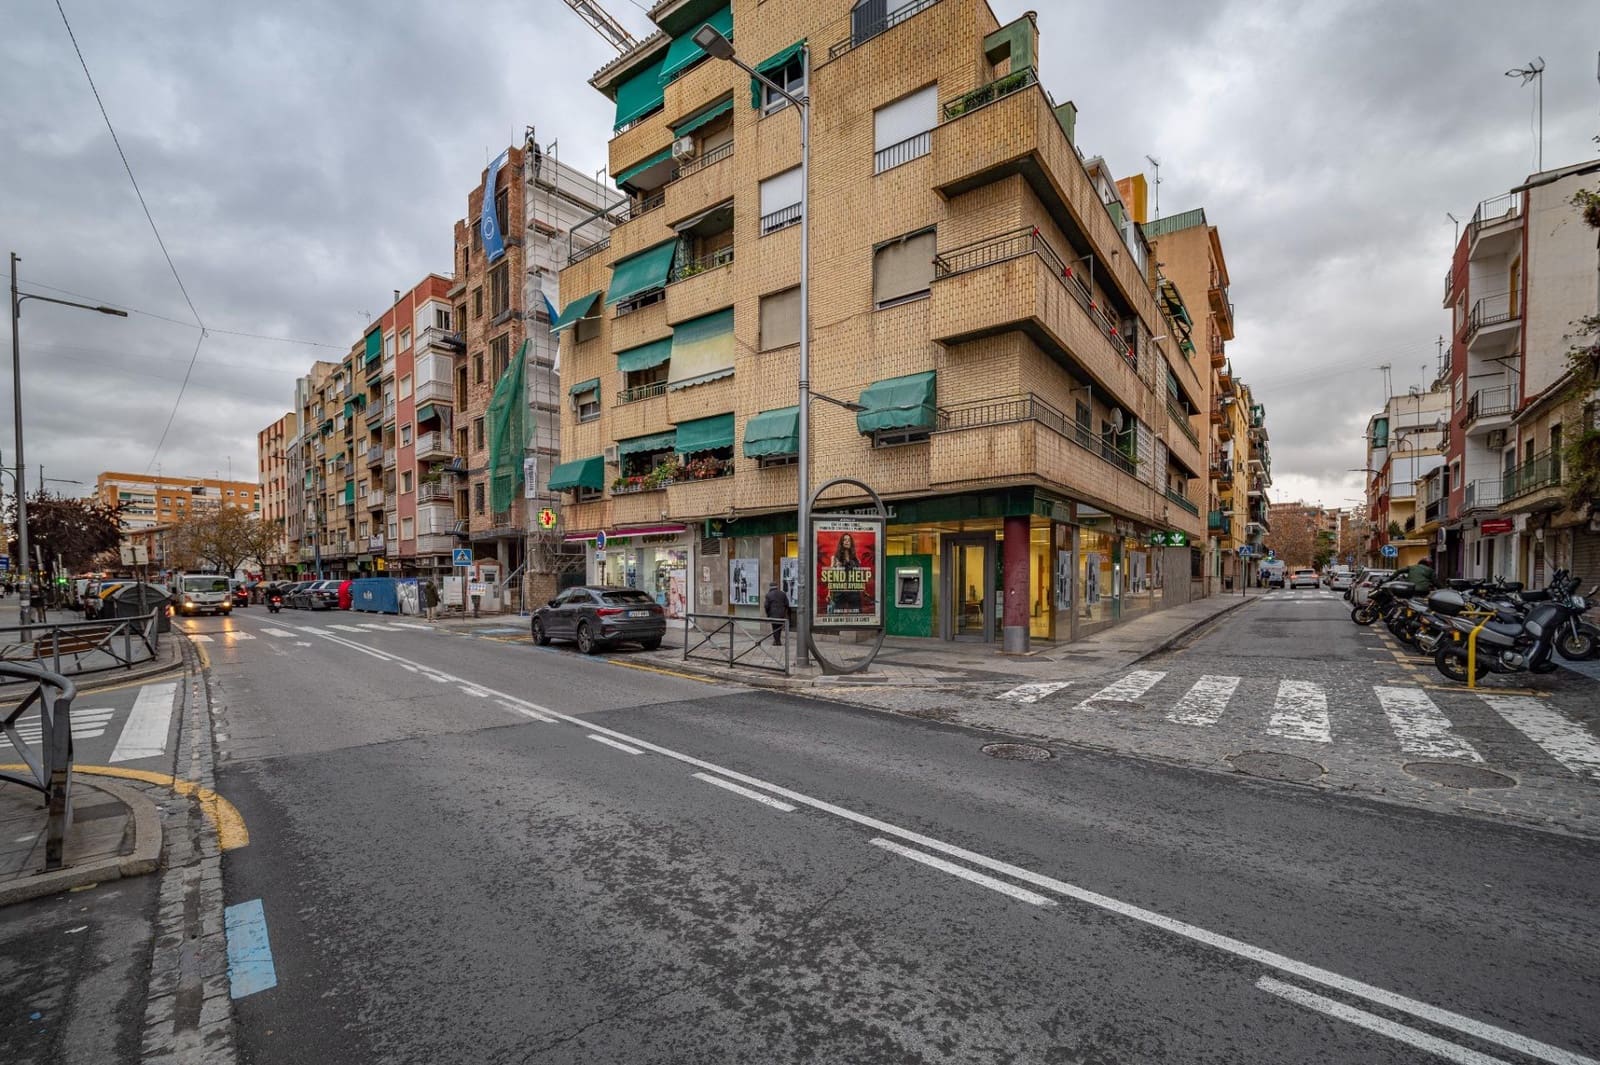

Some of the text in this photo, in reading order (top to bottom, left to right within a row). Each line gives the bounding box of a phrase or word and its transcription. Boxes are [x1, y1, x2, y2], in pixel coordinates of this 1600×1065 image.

[855, 506, 896, 517] RURL
[821, 570, 872, 583] SEND HELP
